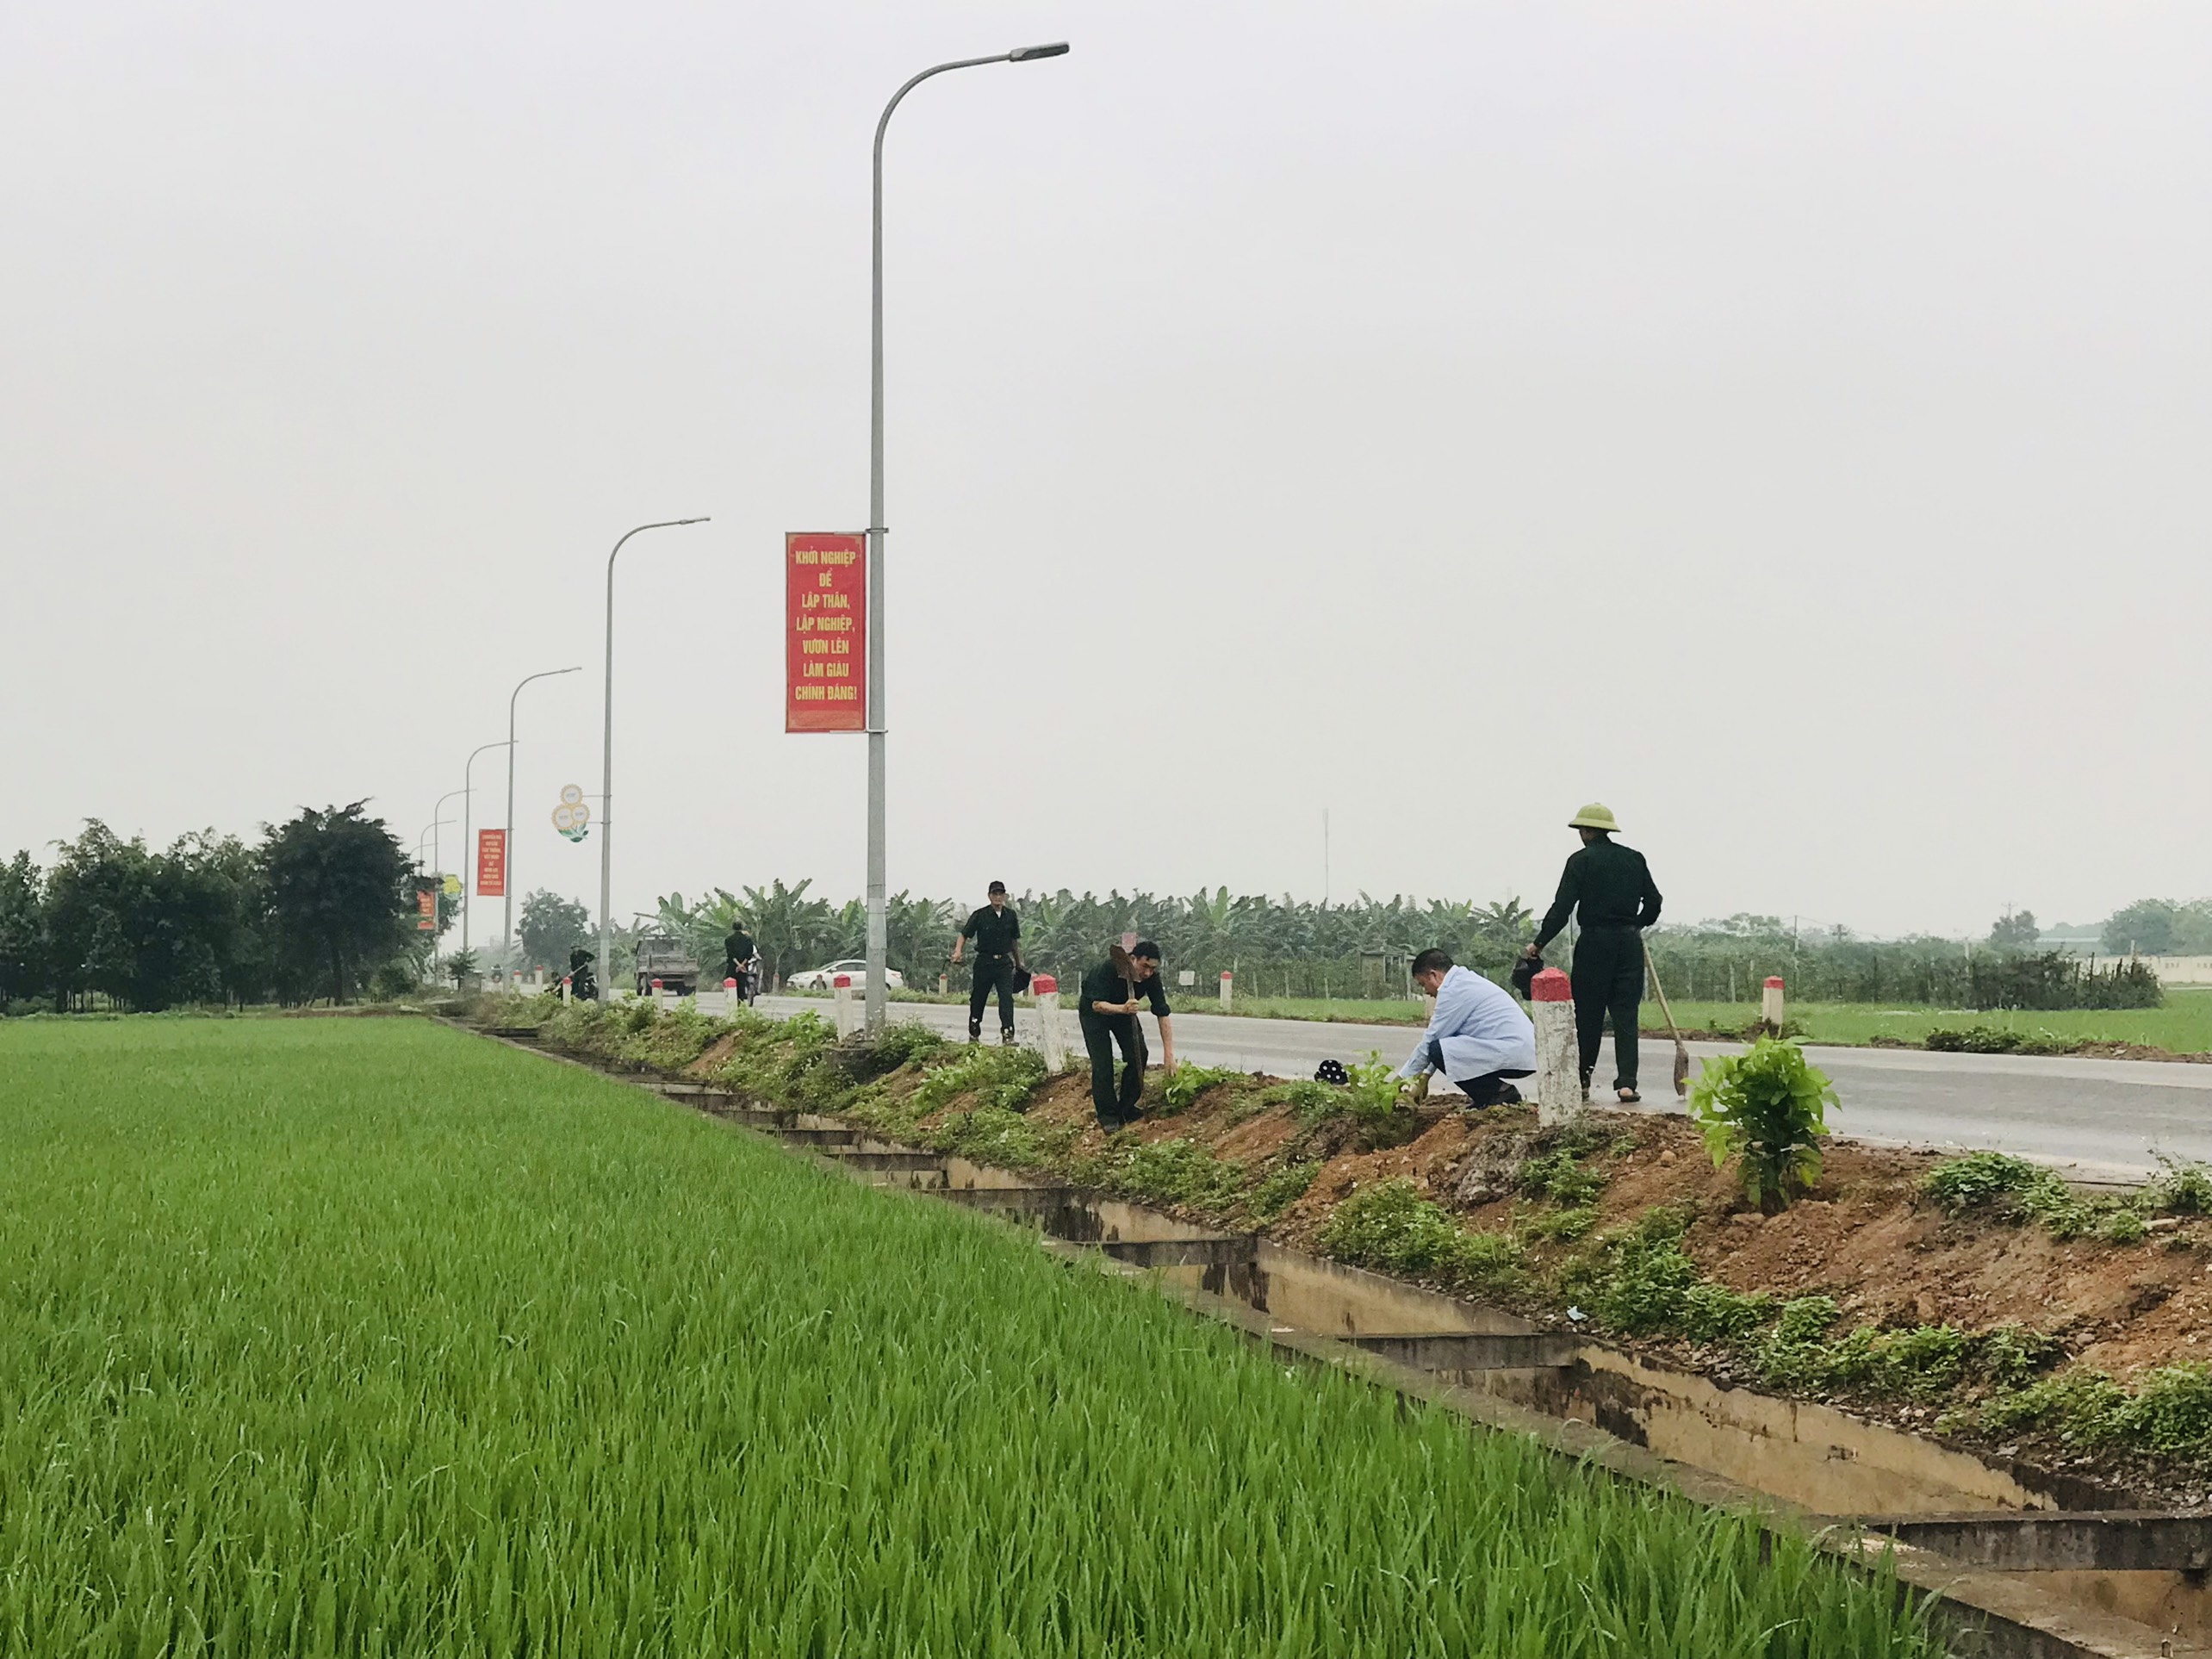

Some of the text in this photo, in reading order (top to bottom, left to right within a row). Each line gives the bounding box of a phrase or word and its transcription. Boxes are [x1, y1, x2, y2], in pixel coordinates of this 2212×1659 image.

[795, 545, 855, 568] KHỞI NGHIỆP
[802, 591, 850, 611] LẬP THÂN,
[796, 613, 855, 634] LẬP NGHIỆP,
[803, 637, 849, 654] VƯƠN LÊN
[803, 660, 849, 677] LÀM GIÀU
[795, 682, 857, 700] CHÍNH ĐÁNG!
